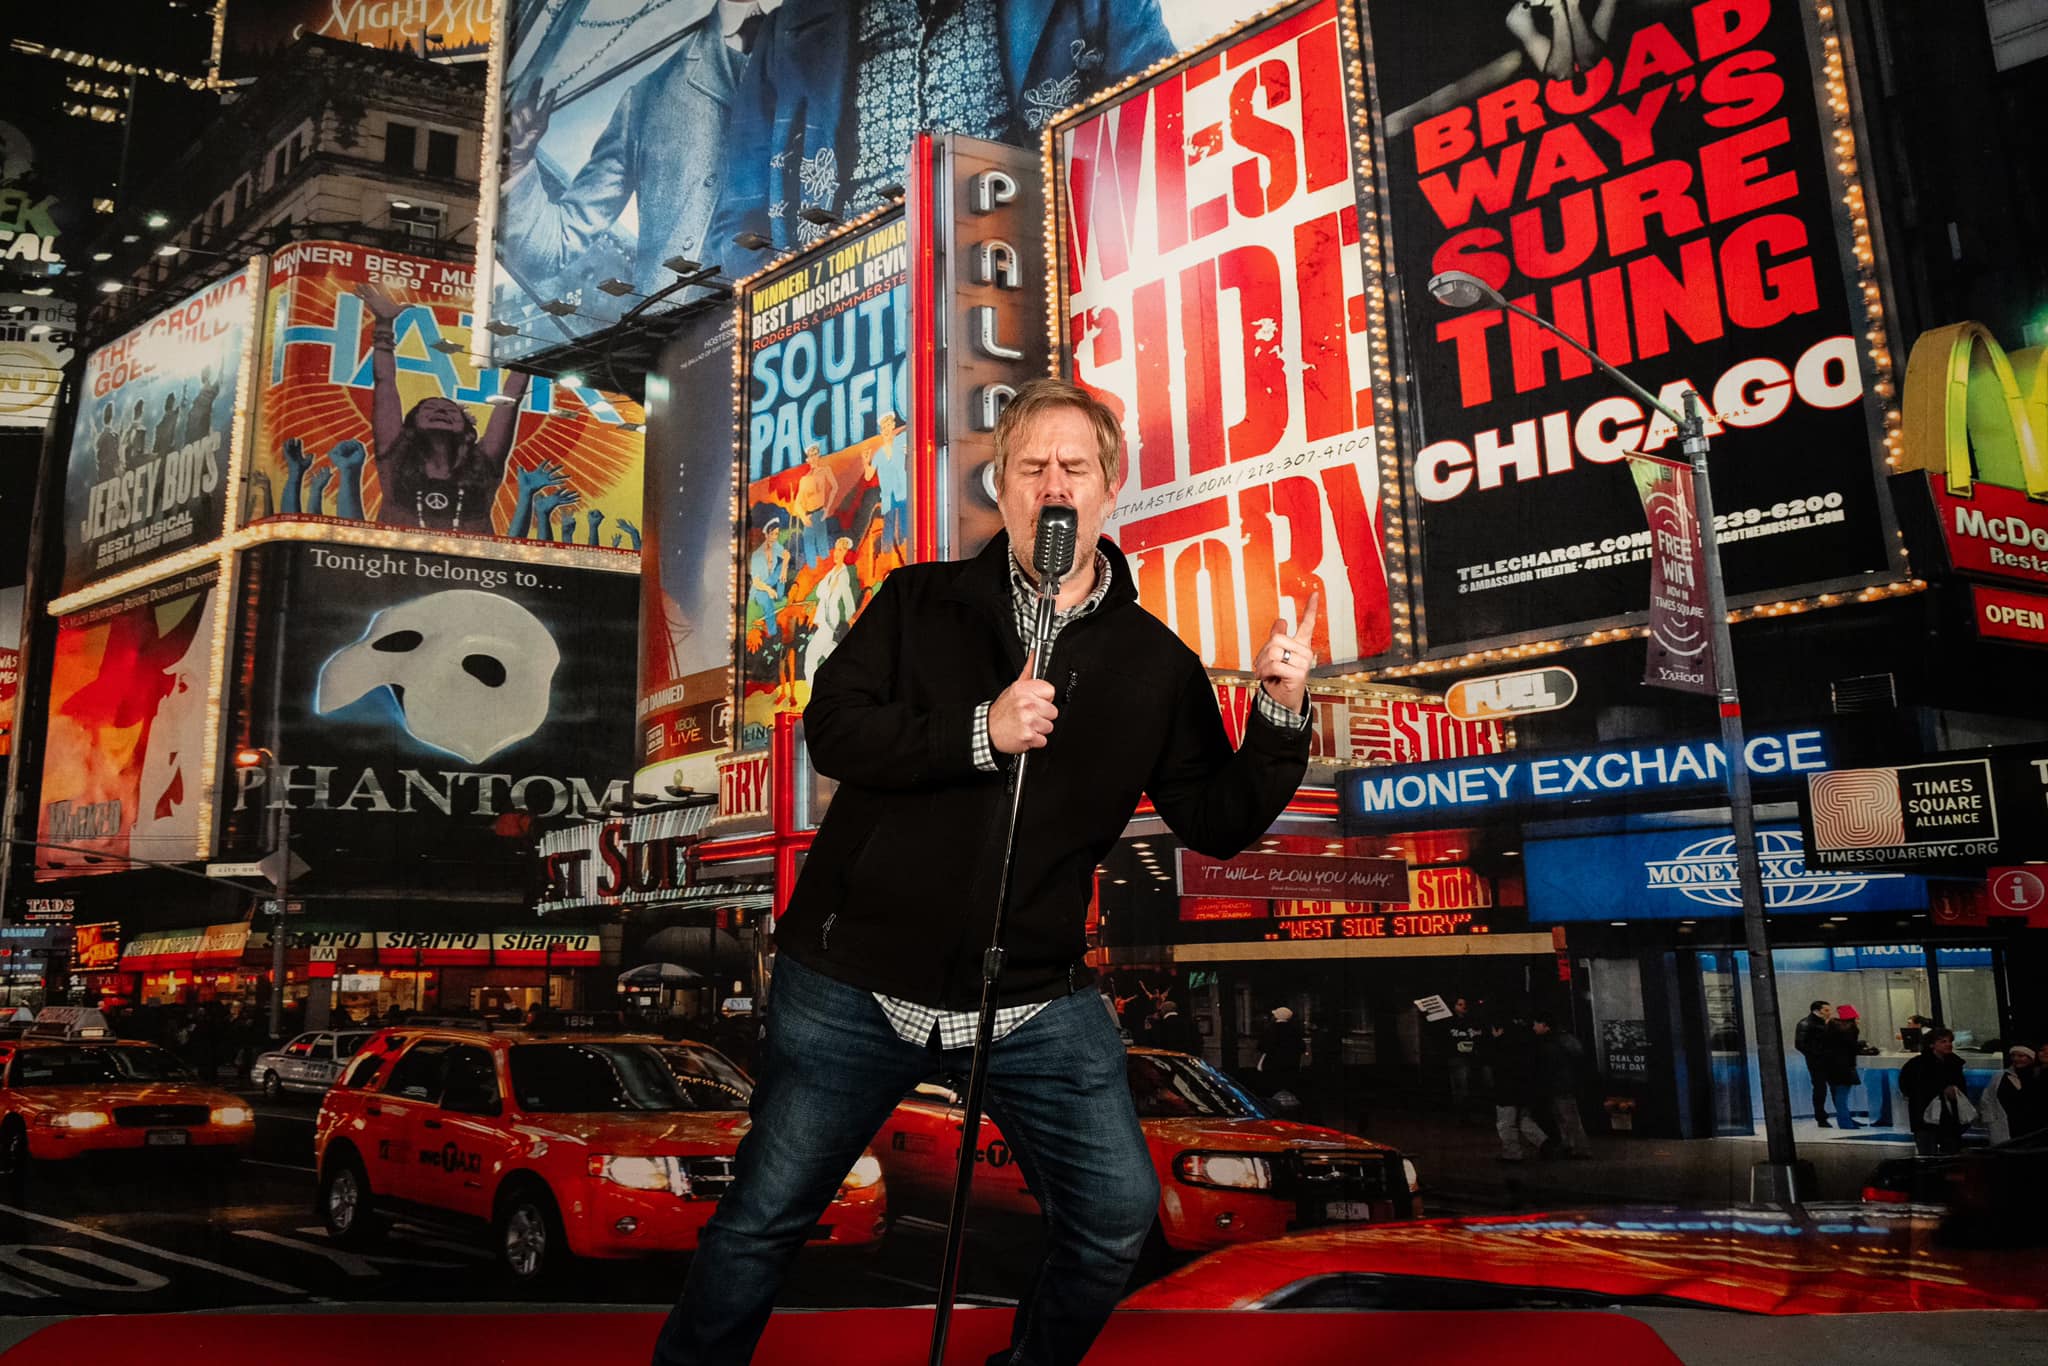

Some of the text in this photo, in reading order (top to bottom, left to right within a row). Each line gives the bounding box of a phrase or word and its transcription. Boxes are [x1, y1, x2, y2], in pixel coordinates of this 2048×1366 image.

[1413, 0, 1772, 174] BROAD
[1064, 0, 1350, 295] WEST
[1417, 49, 1785, 231] WAY'S
[1431, 117, 1800, 307] SURE
[273, 246, 353, 276] WINNER!
[364, 254, 430, 282] BEST
[368, 271, 423, 291] 2009
[752, 271, 810, 315] WINNER!
[813, 263, 823, 286] 7
[827, 240, 866, 277] TONY
[752, 299, 789, 340] BEST
[792, 271, 859, 321] MUSICAL
[1435, 213, 1820, 410] THING
[752, 320, 809, 352] RODGERS
[811, 315, 821, 326] &
[1071, 204, 1376, 490] SIDE
[1413, 335, 1864, 504] CHICAGO
[80, 430, 222, 544] JERSEY BOYS
[97, 509, 194, 557] BEST MUSICAL
[1656, 528, 1694, 562] FREE
[310, 547, 408, 579] Tonight
[415, 557, 508, 589] belongs
[1469, 569, 1534, 594] AMBASSADOR
[1655, 595, 1678, 614] TIMES
[1984, 603, 2045, 630] OPEN
[1658, 665, 1705, 686] YAHOO!
[669, 727, 704, 746] LIVE
[1361, 730, 1827, 813] MONEY EXCHANGE
[1911, 778, 1974, 797] TIMES
[233, 763, 631, 819] PHANTOM
[1908, 794, 1984, 815] SQUARE
[1915, 811, 1980, 828] ALLIANCE
[1817, 840, 1999, 865] TIMESSQUARENYC.ORG
[1224, 867, 1265, 881] WILL
[1268, 867, 1313, 883] BLOW
[1314, 869, 1347, 885] YOU
[385, 932, 480, 949] sbarro
[501, 932, 590, 951] sbarro
[1342, 916, 1388, 939] SIDE
[1628, 1063, 1647, 1071] DAY
